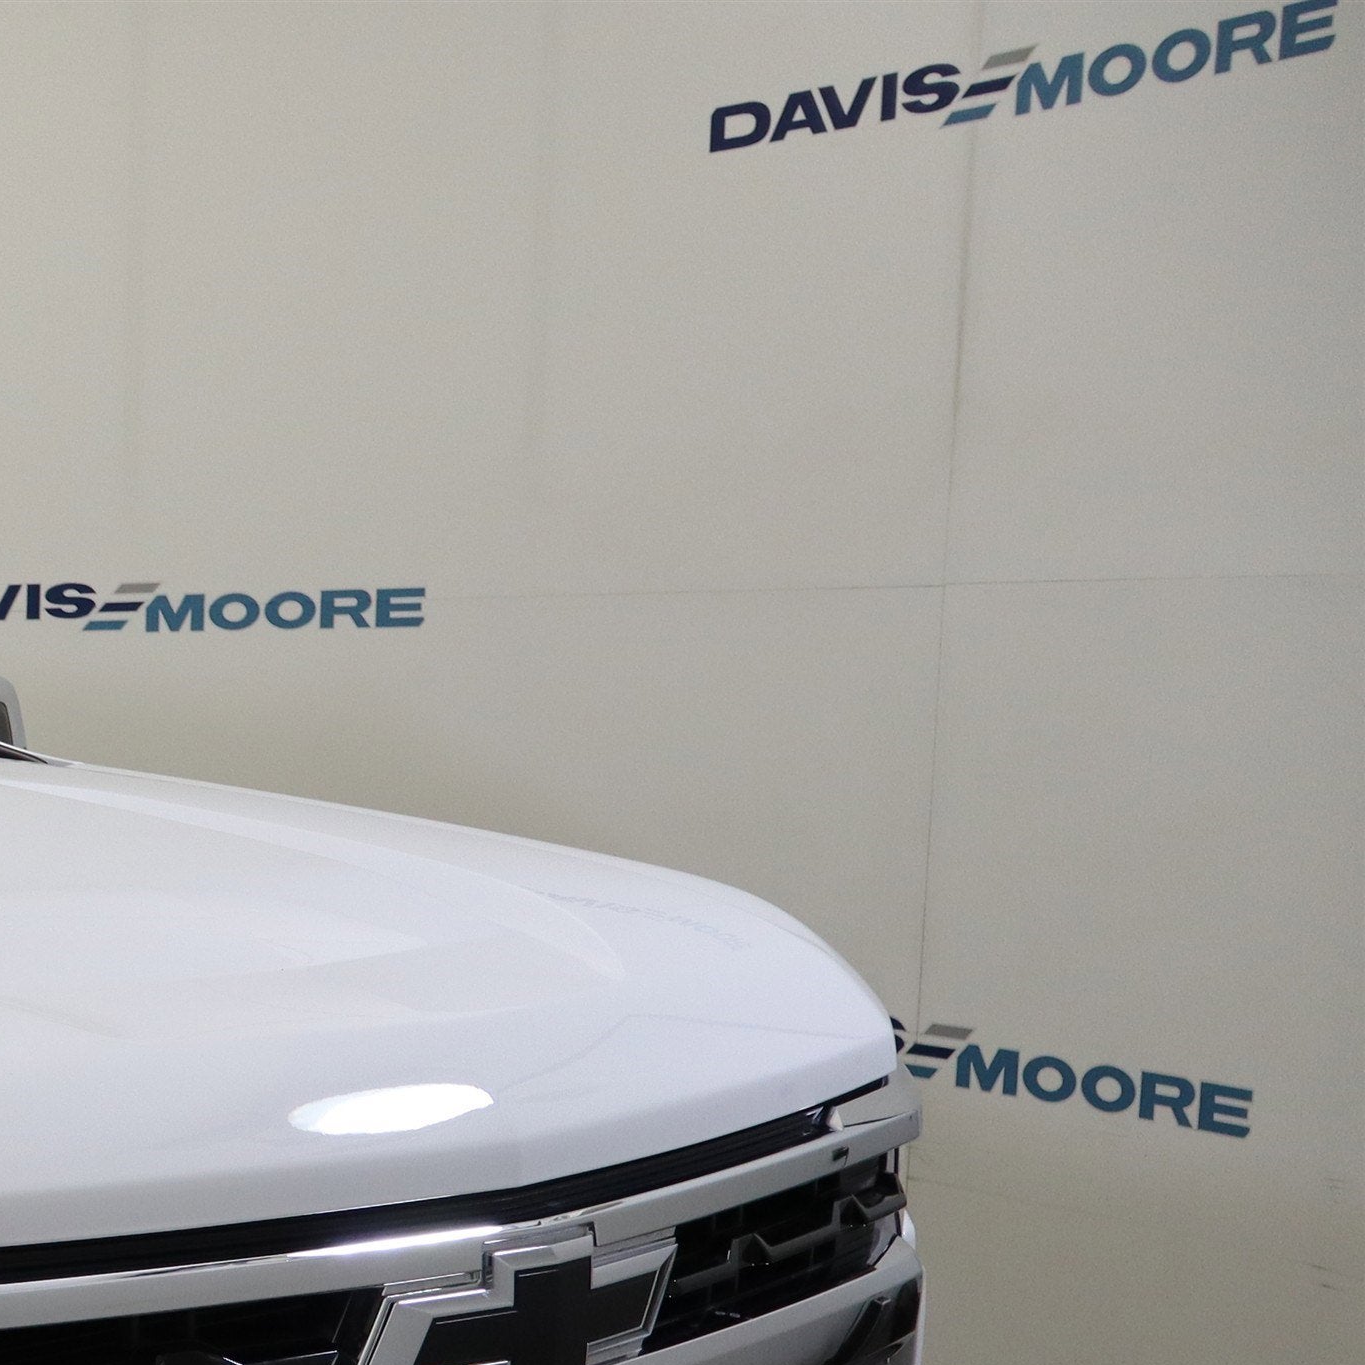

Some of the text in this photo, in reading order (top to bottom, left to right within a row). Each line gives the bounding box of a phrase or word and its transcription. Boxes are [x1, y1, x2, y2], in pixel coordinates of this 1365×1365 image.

[709, 0, 1338, 153] DAVIS MOORE
[145, 587, 426, 632] MOORE
[954, 1043, 1254, 1138] MOORE
